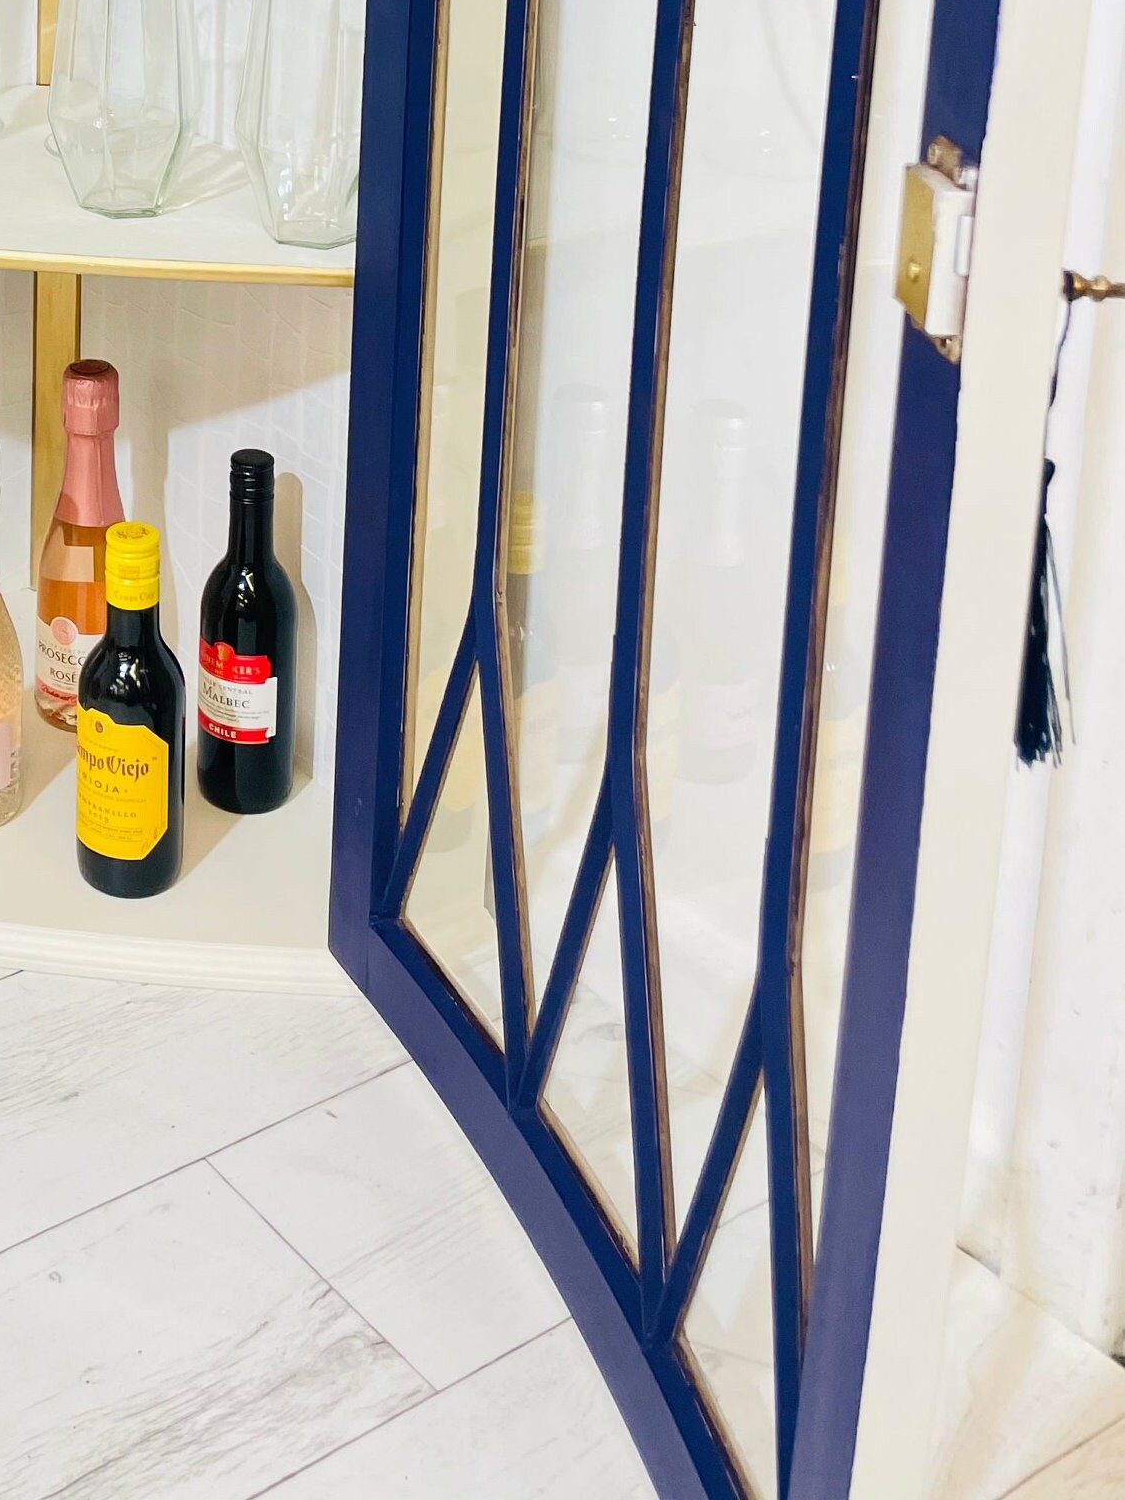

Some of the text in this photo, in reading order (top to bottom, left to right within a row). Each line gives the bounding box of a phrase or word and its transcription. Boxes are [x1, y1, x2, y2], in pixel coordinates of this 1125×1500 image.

[38, 640, 86, 667] PROSECC
[202, 682, 251, 709] MALBEC
[208, 722, 237, 739] CHILE
[106, 755, 150, 782] Viejo
[81, 772, 120, 794] RIOJA
